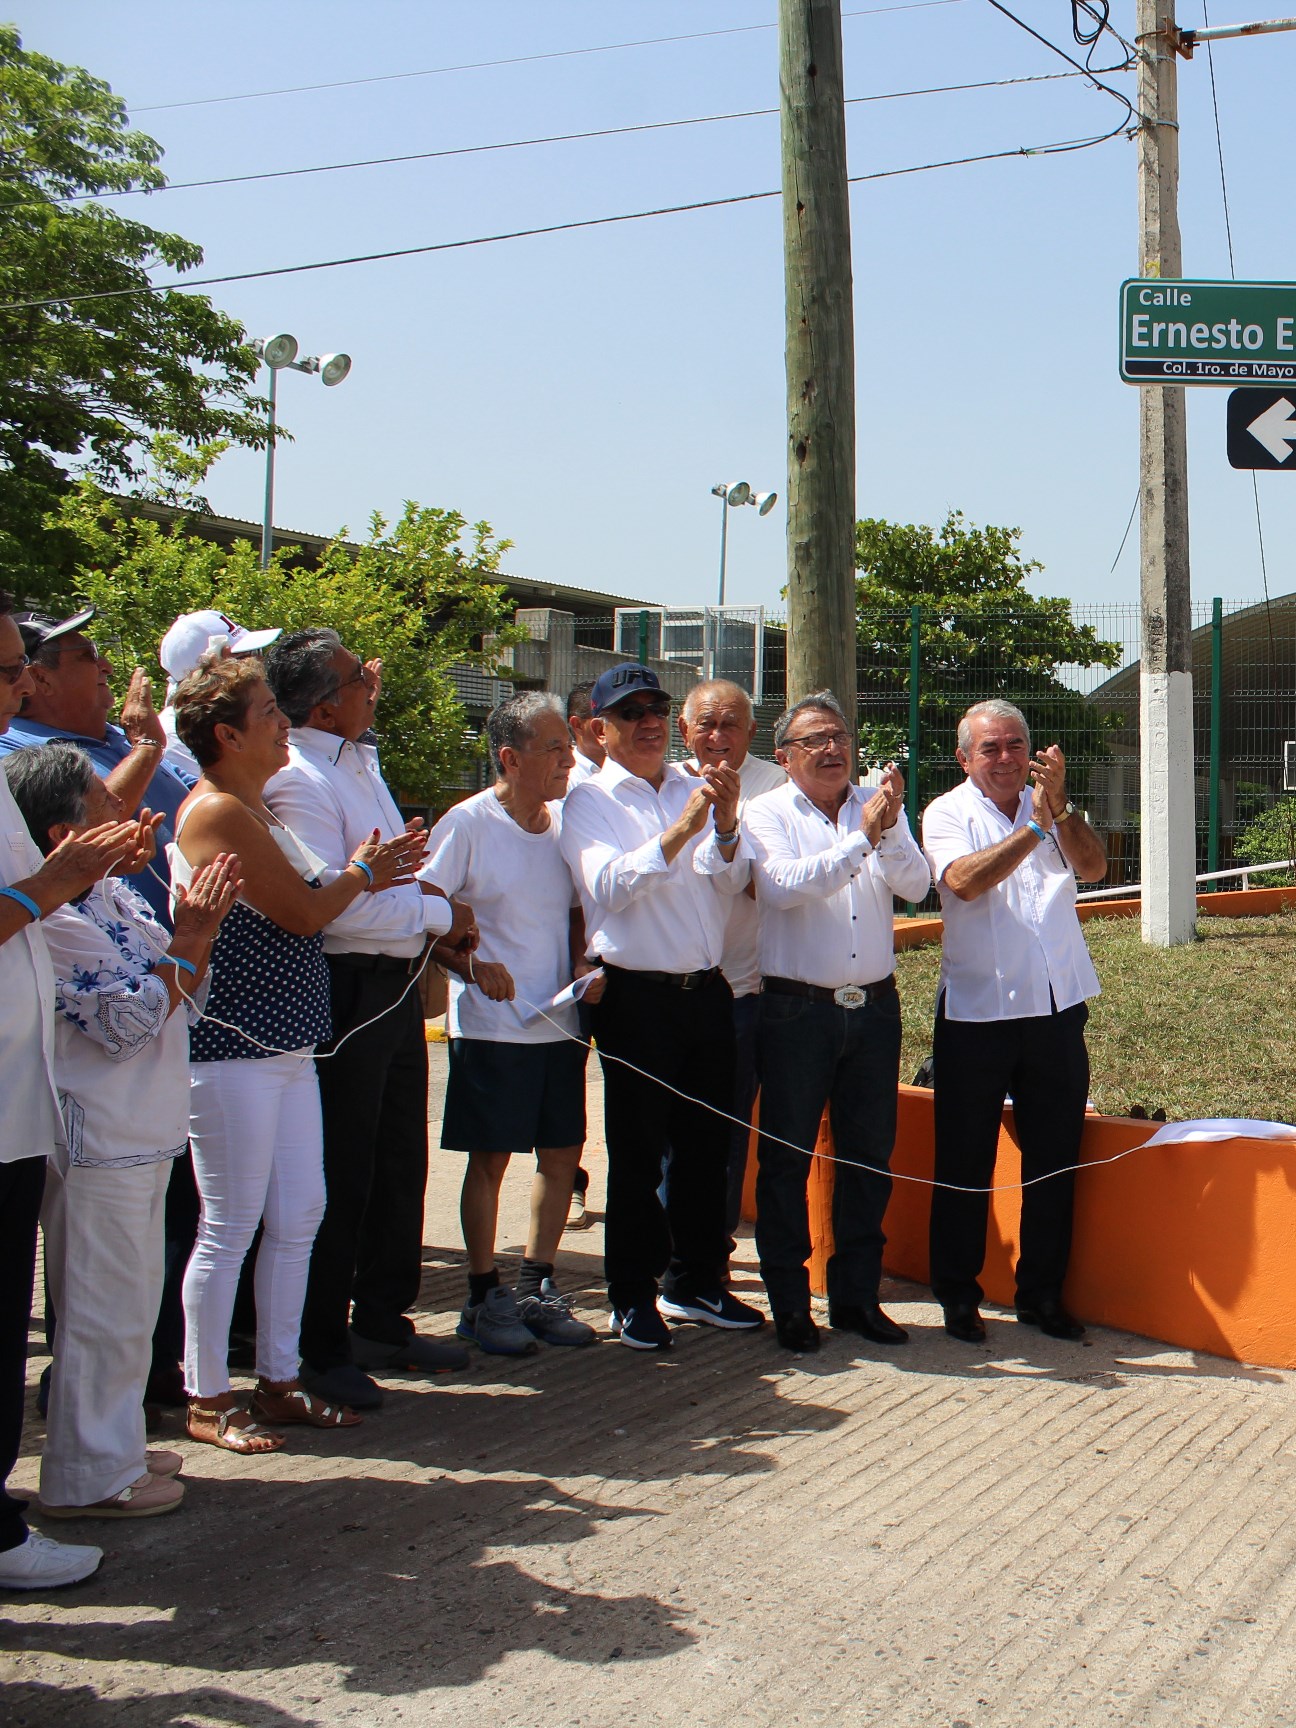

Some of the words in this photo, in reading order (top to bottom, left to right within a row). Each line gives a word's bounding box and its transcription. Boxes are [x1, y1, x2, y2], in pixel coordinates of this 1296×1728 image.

[1139, 288, 1192, 306] Calle
[1131, 314, 1264, 350] Ernesto
[1162, 361, 1191, 374] Col.
[1196, 362, 1225, 375] 1ro.
[1229, 363, 1248, 376] de
[1252, 364, 1294, 379] Mayo
[612, 669, 656, 688] UFC
